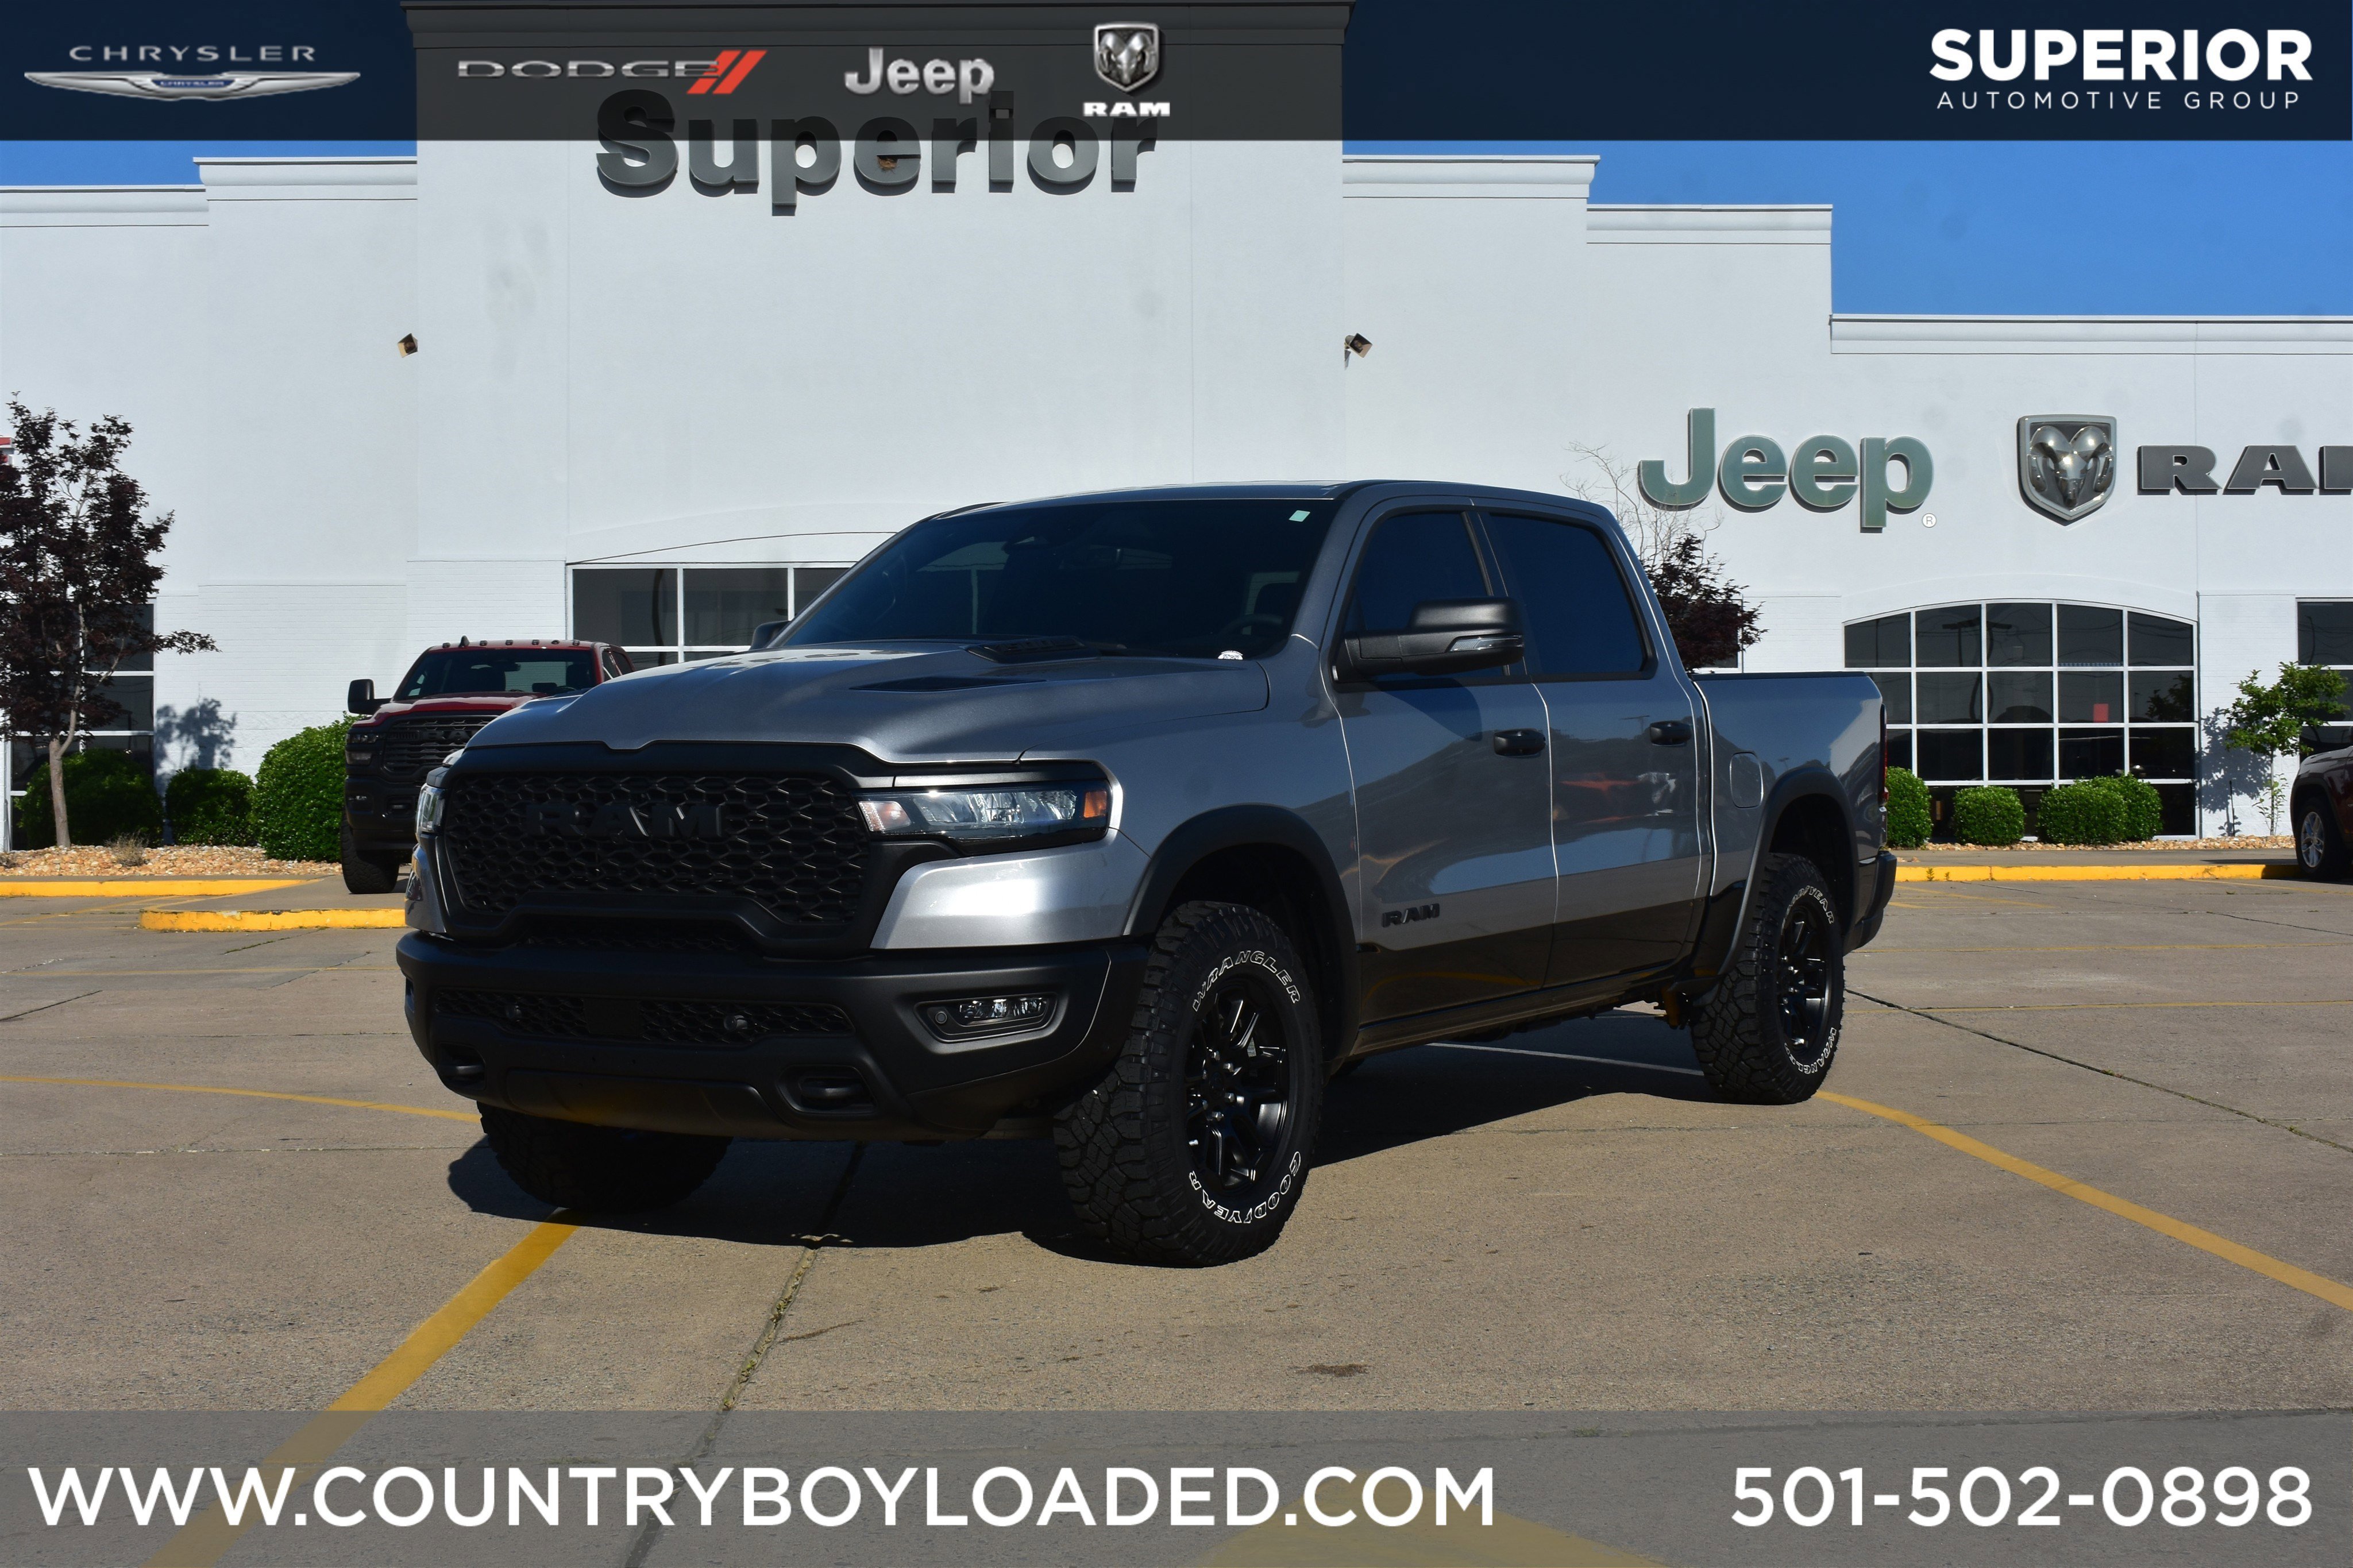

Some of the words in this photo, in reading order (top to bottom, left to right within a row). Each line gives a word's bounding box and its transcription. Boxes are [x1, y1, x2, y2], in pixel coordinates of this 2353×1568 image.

[596, 89, 1158, 216] Superior
[1637, 407, 1934, 532] Jeep
[423, 730, 476, 741] RA
[526, 802, 726, 837] RAM
[1382, 903, 1440, 928] RAM
[1781, 885, 1834, 935] ODYEAR
[1192, 950, 1300, 1013] WRANGLER
[1188, 1151, 1302, 1224] GOODYEAR
